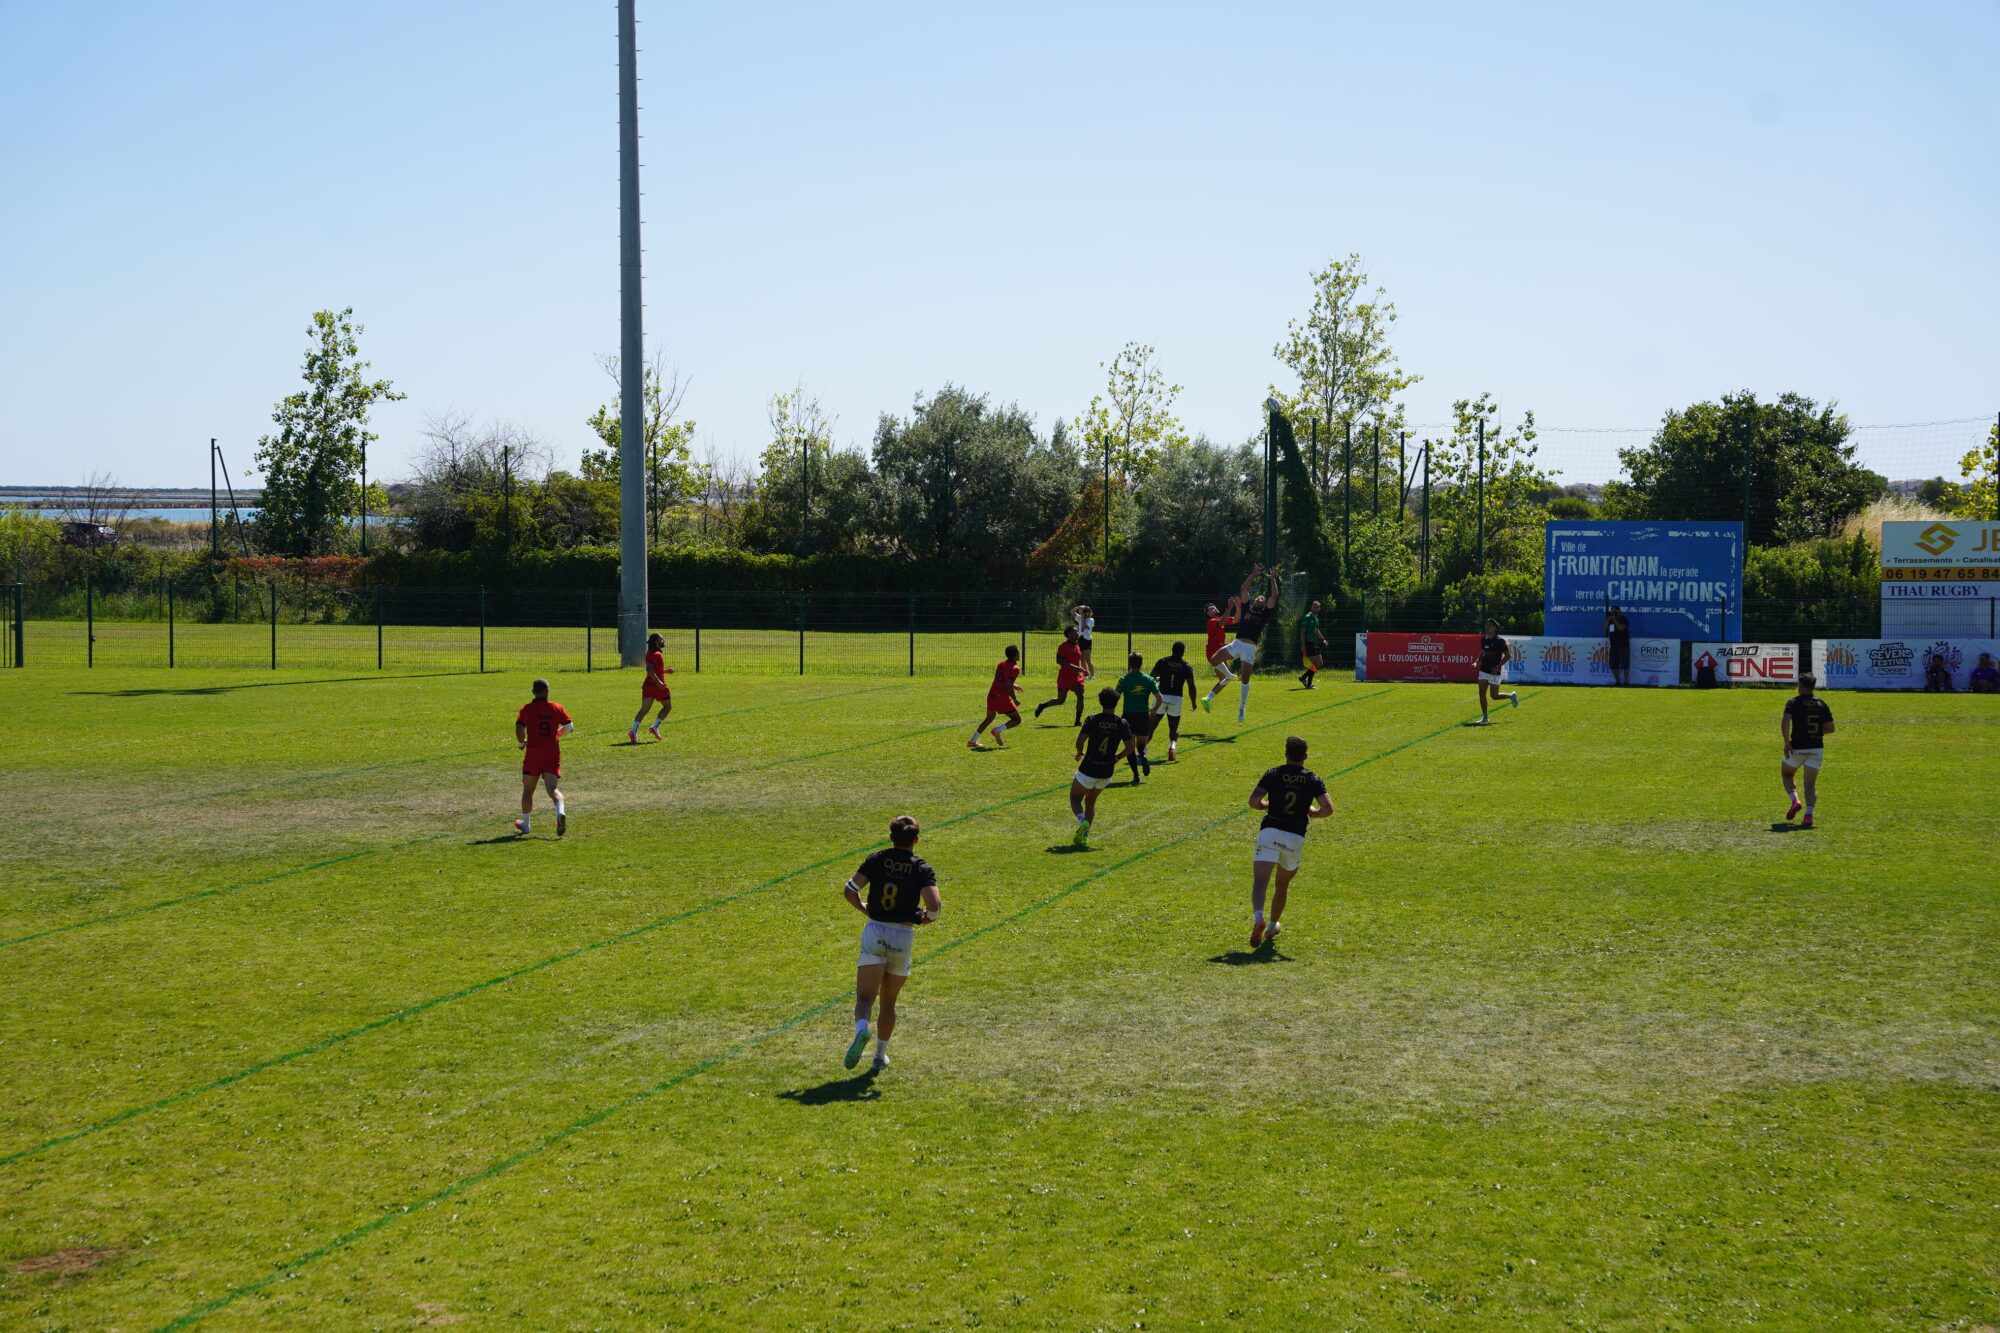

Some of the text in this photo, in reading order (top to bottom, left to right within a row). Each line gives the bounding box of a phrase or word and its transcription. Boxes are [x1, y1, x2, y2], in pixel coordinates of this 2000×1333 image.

[1561, 541, 1587, 552] Ville de
[1558, 555, 1699, 578] FRONTIGNAN la peyrade
[1886, 569, 2000, 579] 06 19 47 65 84
[1576, 581, 1727, 602] terre de CHAMPIONS
[1888, 586, 1981, 596] THAU RUGBY
[1716, 646, 1759, 656] RADIO
[1870, 650, 1912, 659] SEVENS
[1379, 654, 1386, 662] LE
[1388, 654, 1430, 662] TOULOUSAIN
[1872, 658, 1909, 666] FESTIVAL
[1542, 661, 1574, 672] SEVENS
[1726, 657, 1793, 678] ONE
[1824, 664, 1858, 675] SEVENS
[1807, 715, 1819, 733] 5
[1098, 737, 1110, 755] 4
[1284, 791, 1297, 815] 2
[881, 882, 898, 911] 8
